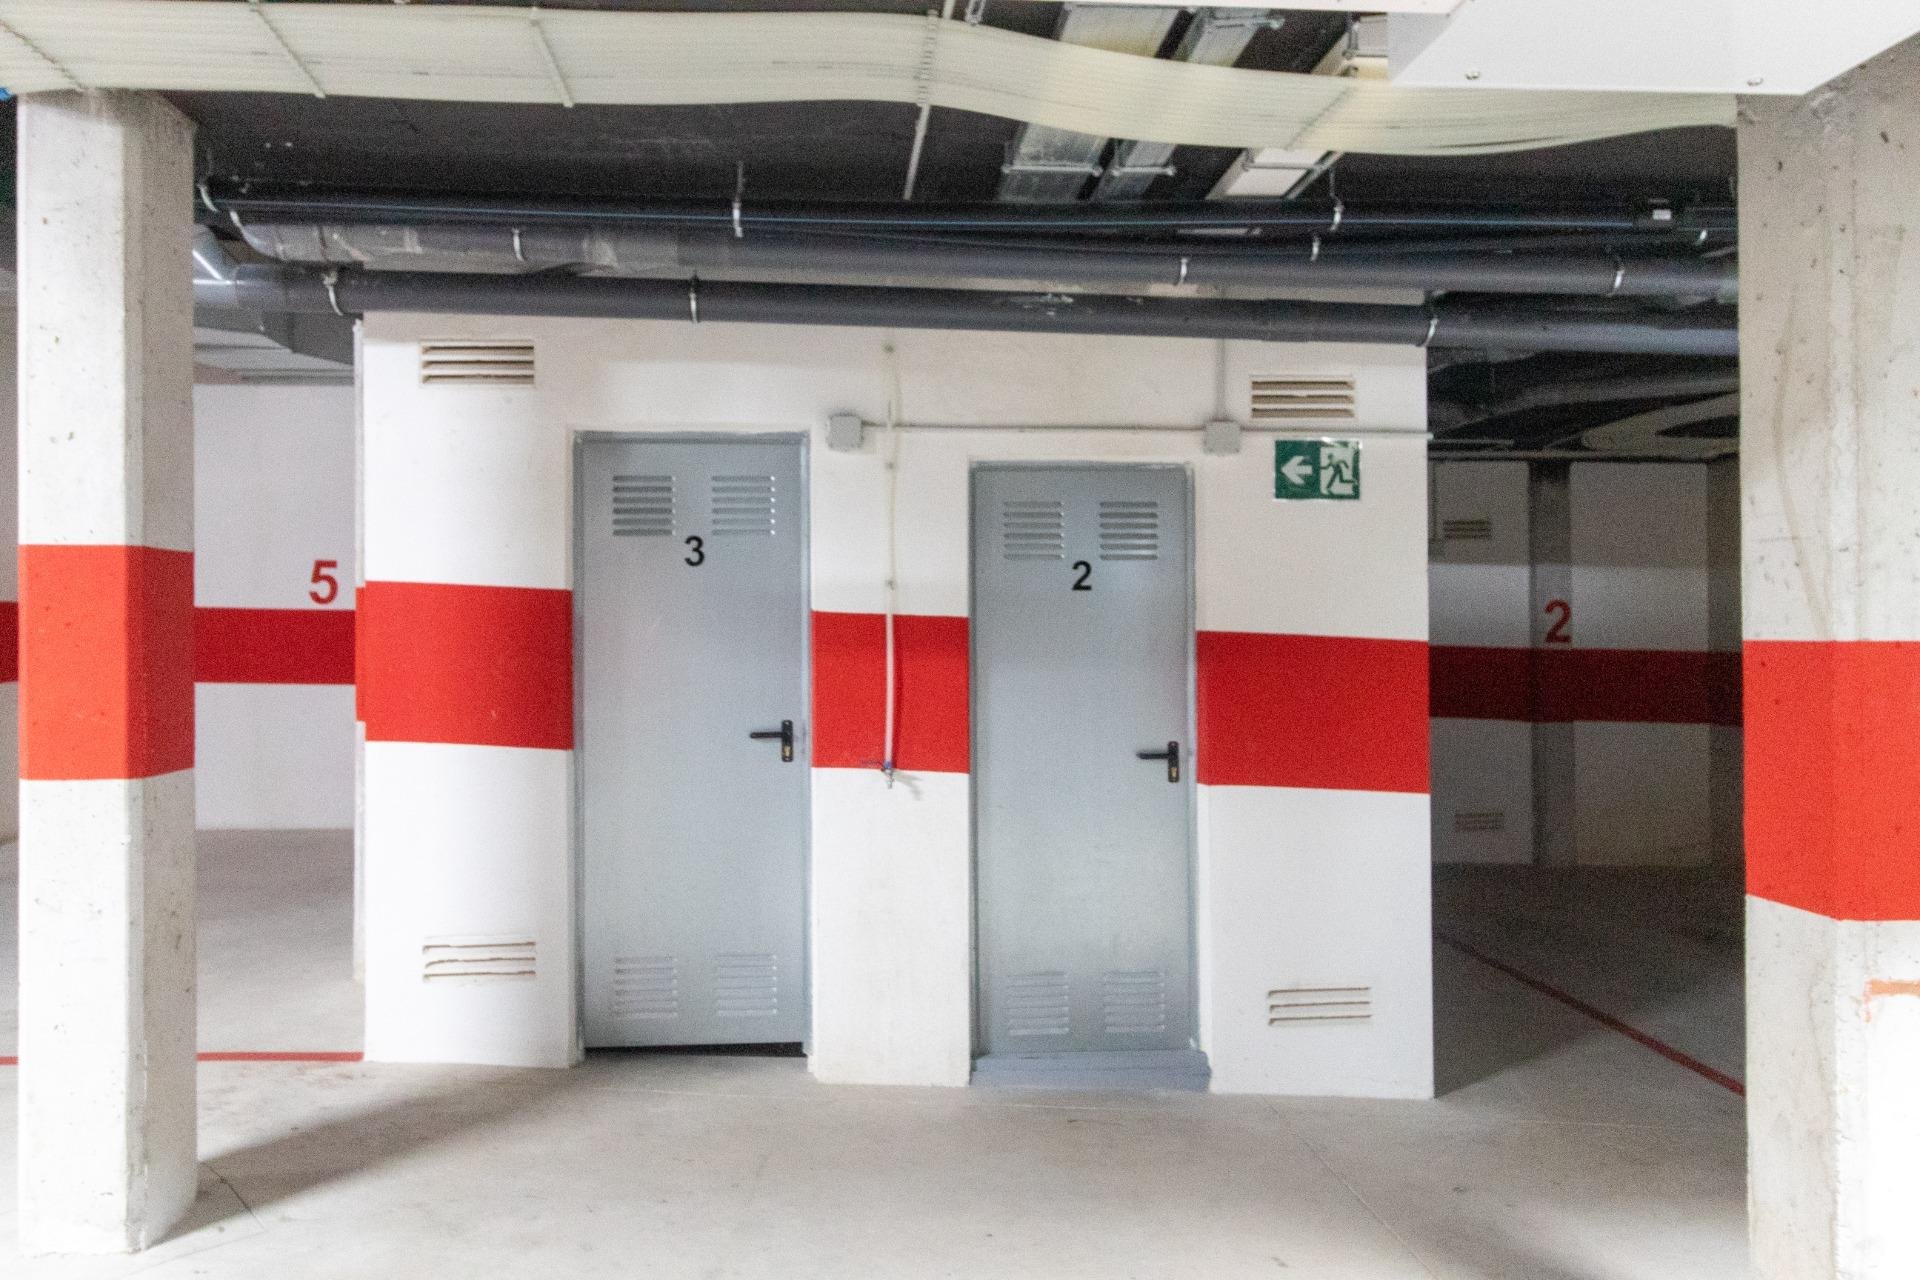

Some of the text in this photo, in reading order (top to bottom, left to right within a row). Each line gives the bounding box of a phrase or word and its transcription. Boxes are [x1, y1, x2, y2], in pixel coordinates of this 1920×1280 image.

[684, 535, 706, 567] 3
[308, 559, 338, 604] 5
[1072, 560, 1092, 592] 2
[1545, 600, 1572, 643] 2
